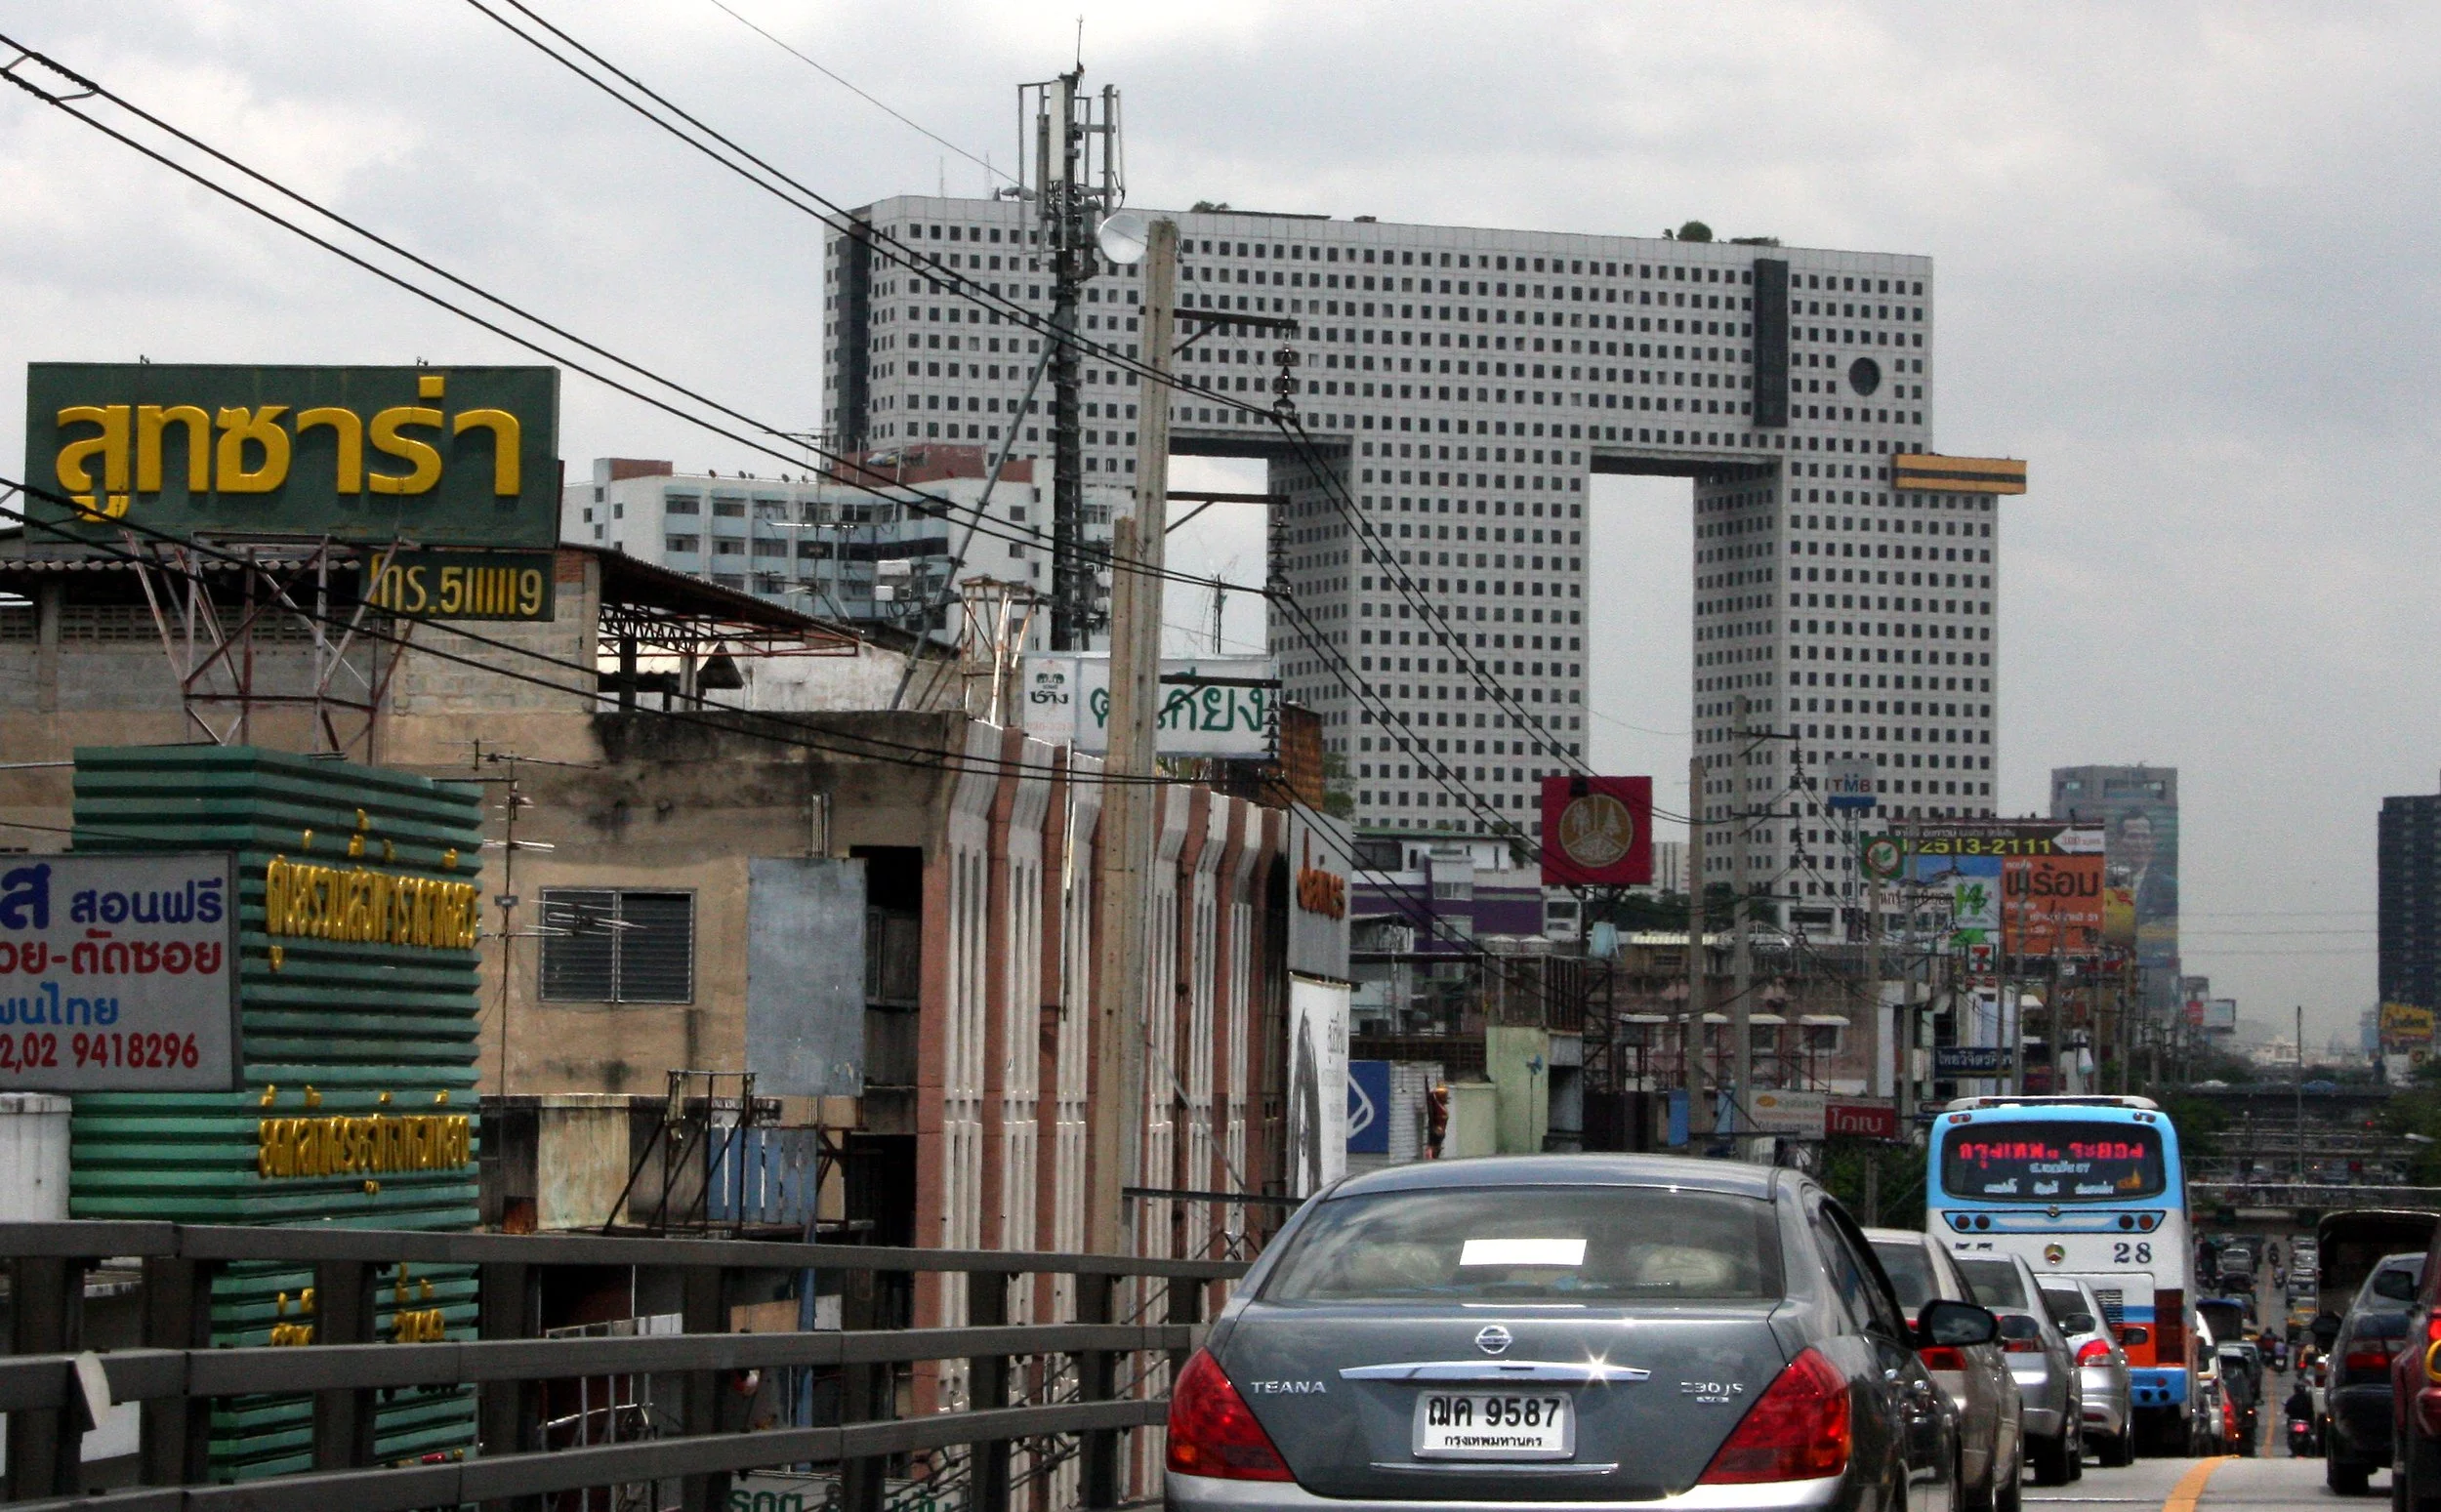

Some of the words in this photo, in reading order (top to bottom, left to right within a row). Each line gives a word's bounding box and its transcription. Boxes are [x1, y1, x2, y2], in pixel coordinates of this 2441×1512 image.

[440, 566, 543, 616] 5111119
[1832, 777, 1871, 793] TMB
[0, 862, 52, 930] ส
[70, 877, 224, 924] สอนฟรี
[71, 1032, 199, 1069] 9418296
[1832, 1108, 1883, 1132] โกเบ
[2069, 1142, 2144, 1160] ระยอง
[2114, 1242, 2152, 1264] 28
[1251, 1380, 1326, 1395] TEANA
[1485, 1397, 1560, 1428] 9587
[1445, 1435, 1542, 1449] กรุงเทพมหานคร
